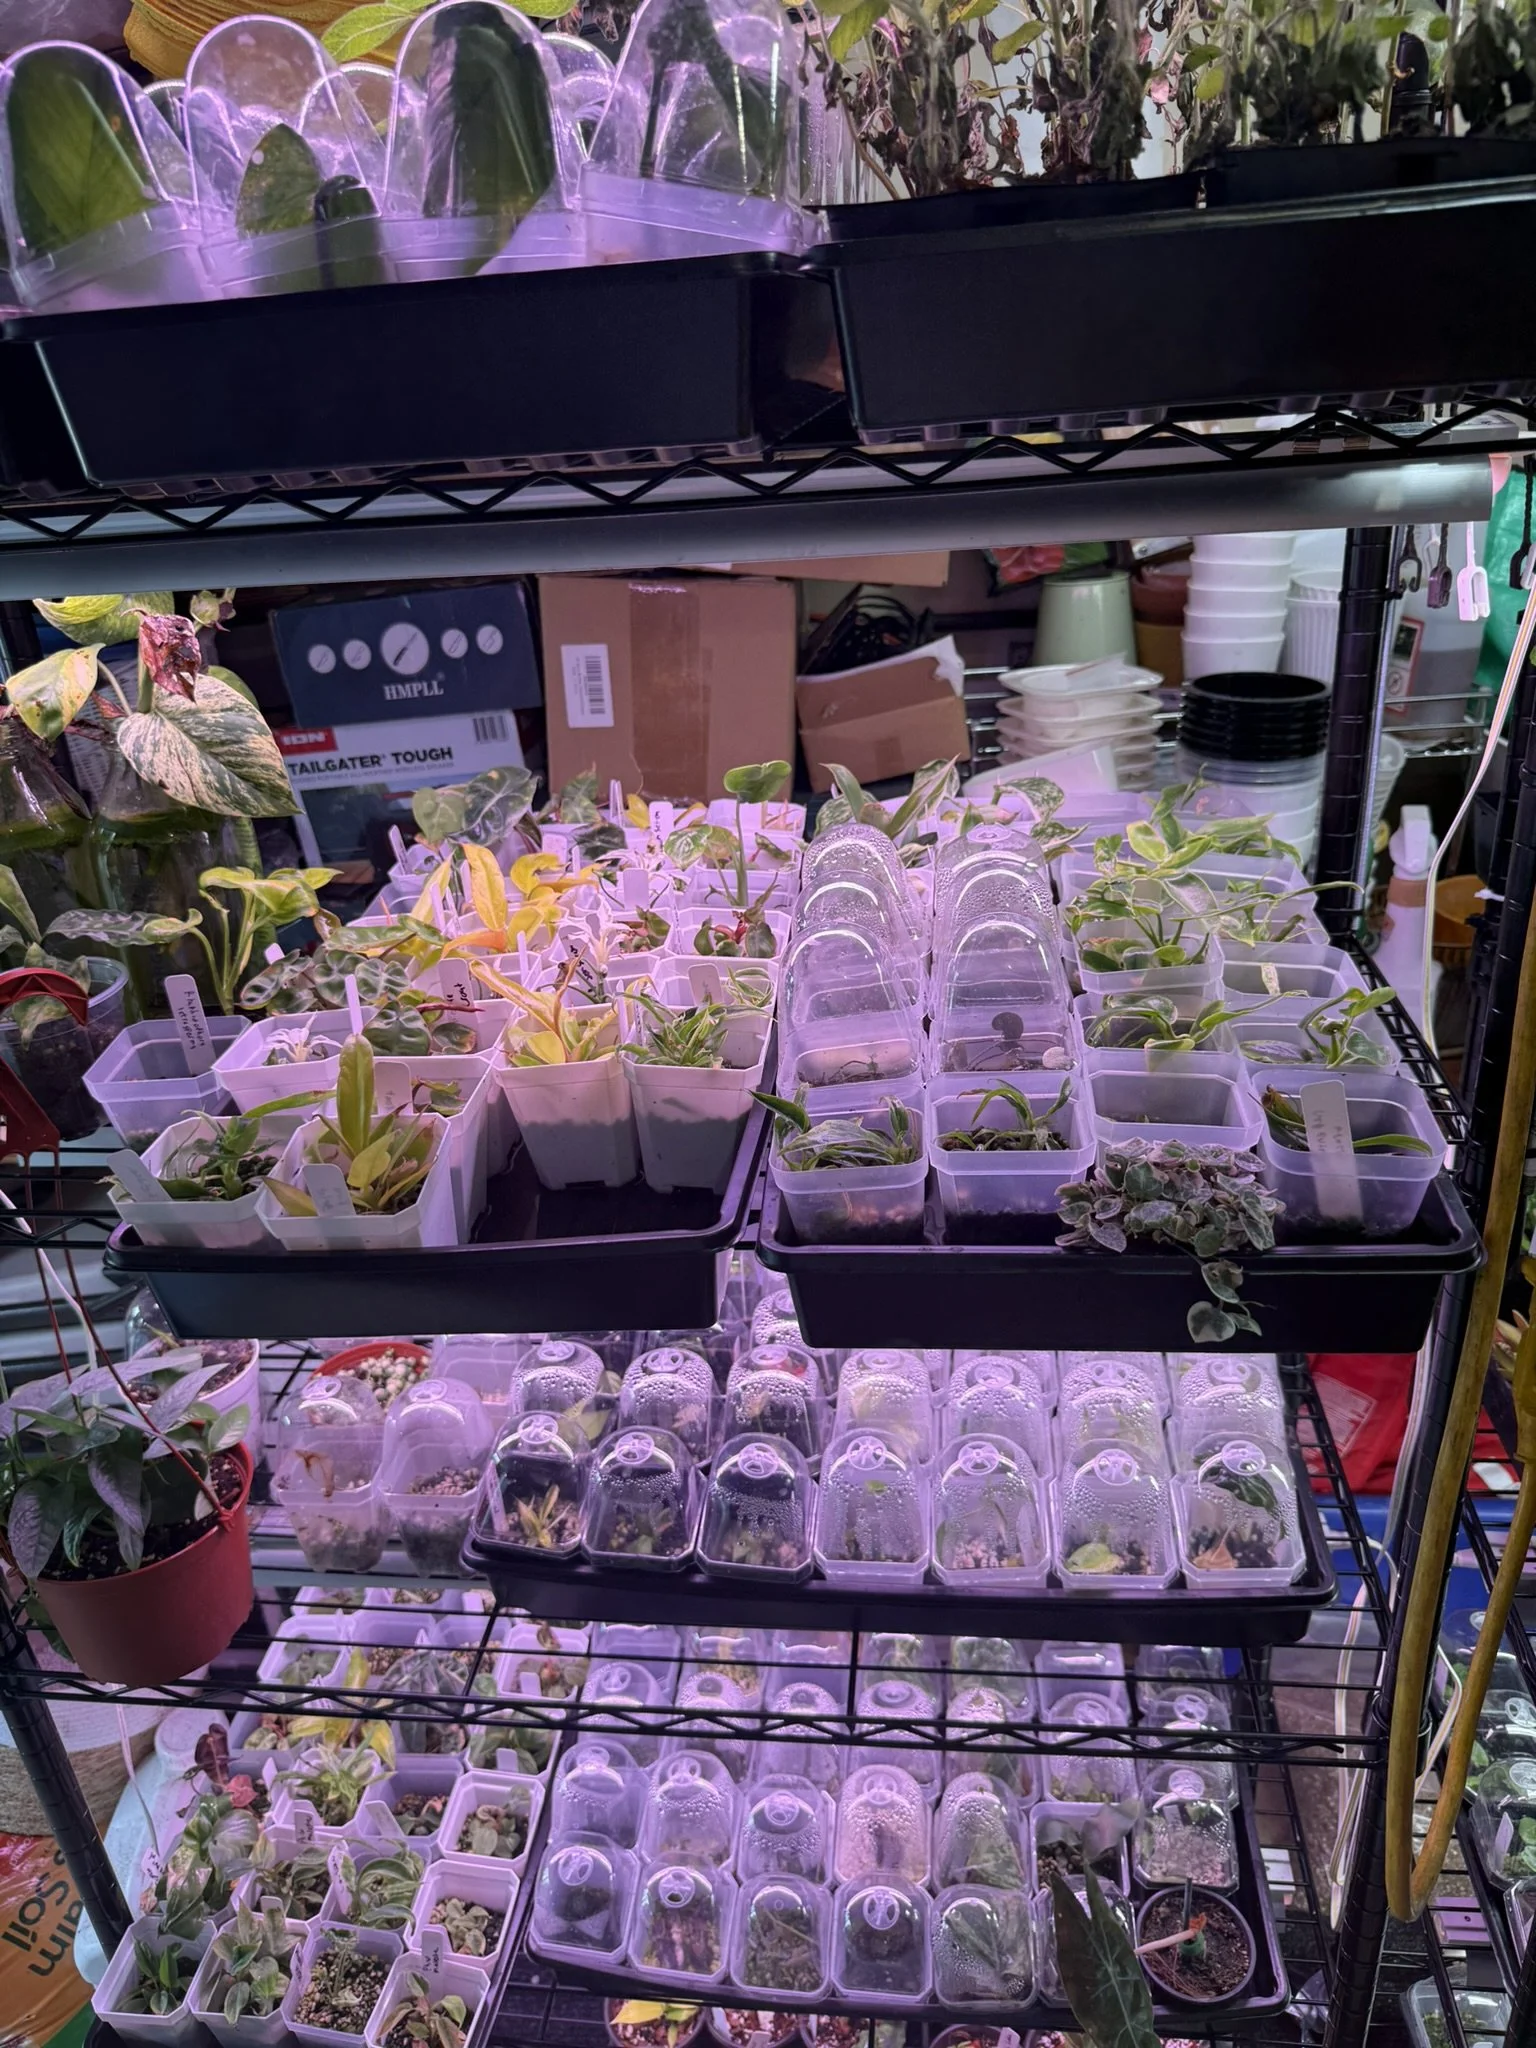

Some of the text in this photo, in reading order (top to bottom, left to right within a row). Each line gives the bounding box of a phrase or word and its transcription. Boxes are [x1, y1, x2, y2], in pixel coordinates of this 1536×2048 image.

[288, 747, 453, 776] TAILGATER TOUGH
[1, 1872, 70, 1953] Soil
[28, 1900, 84, 1976] alm
